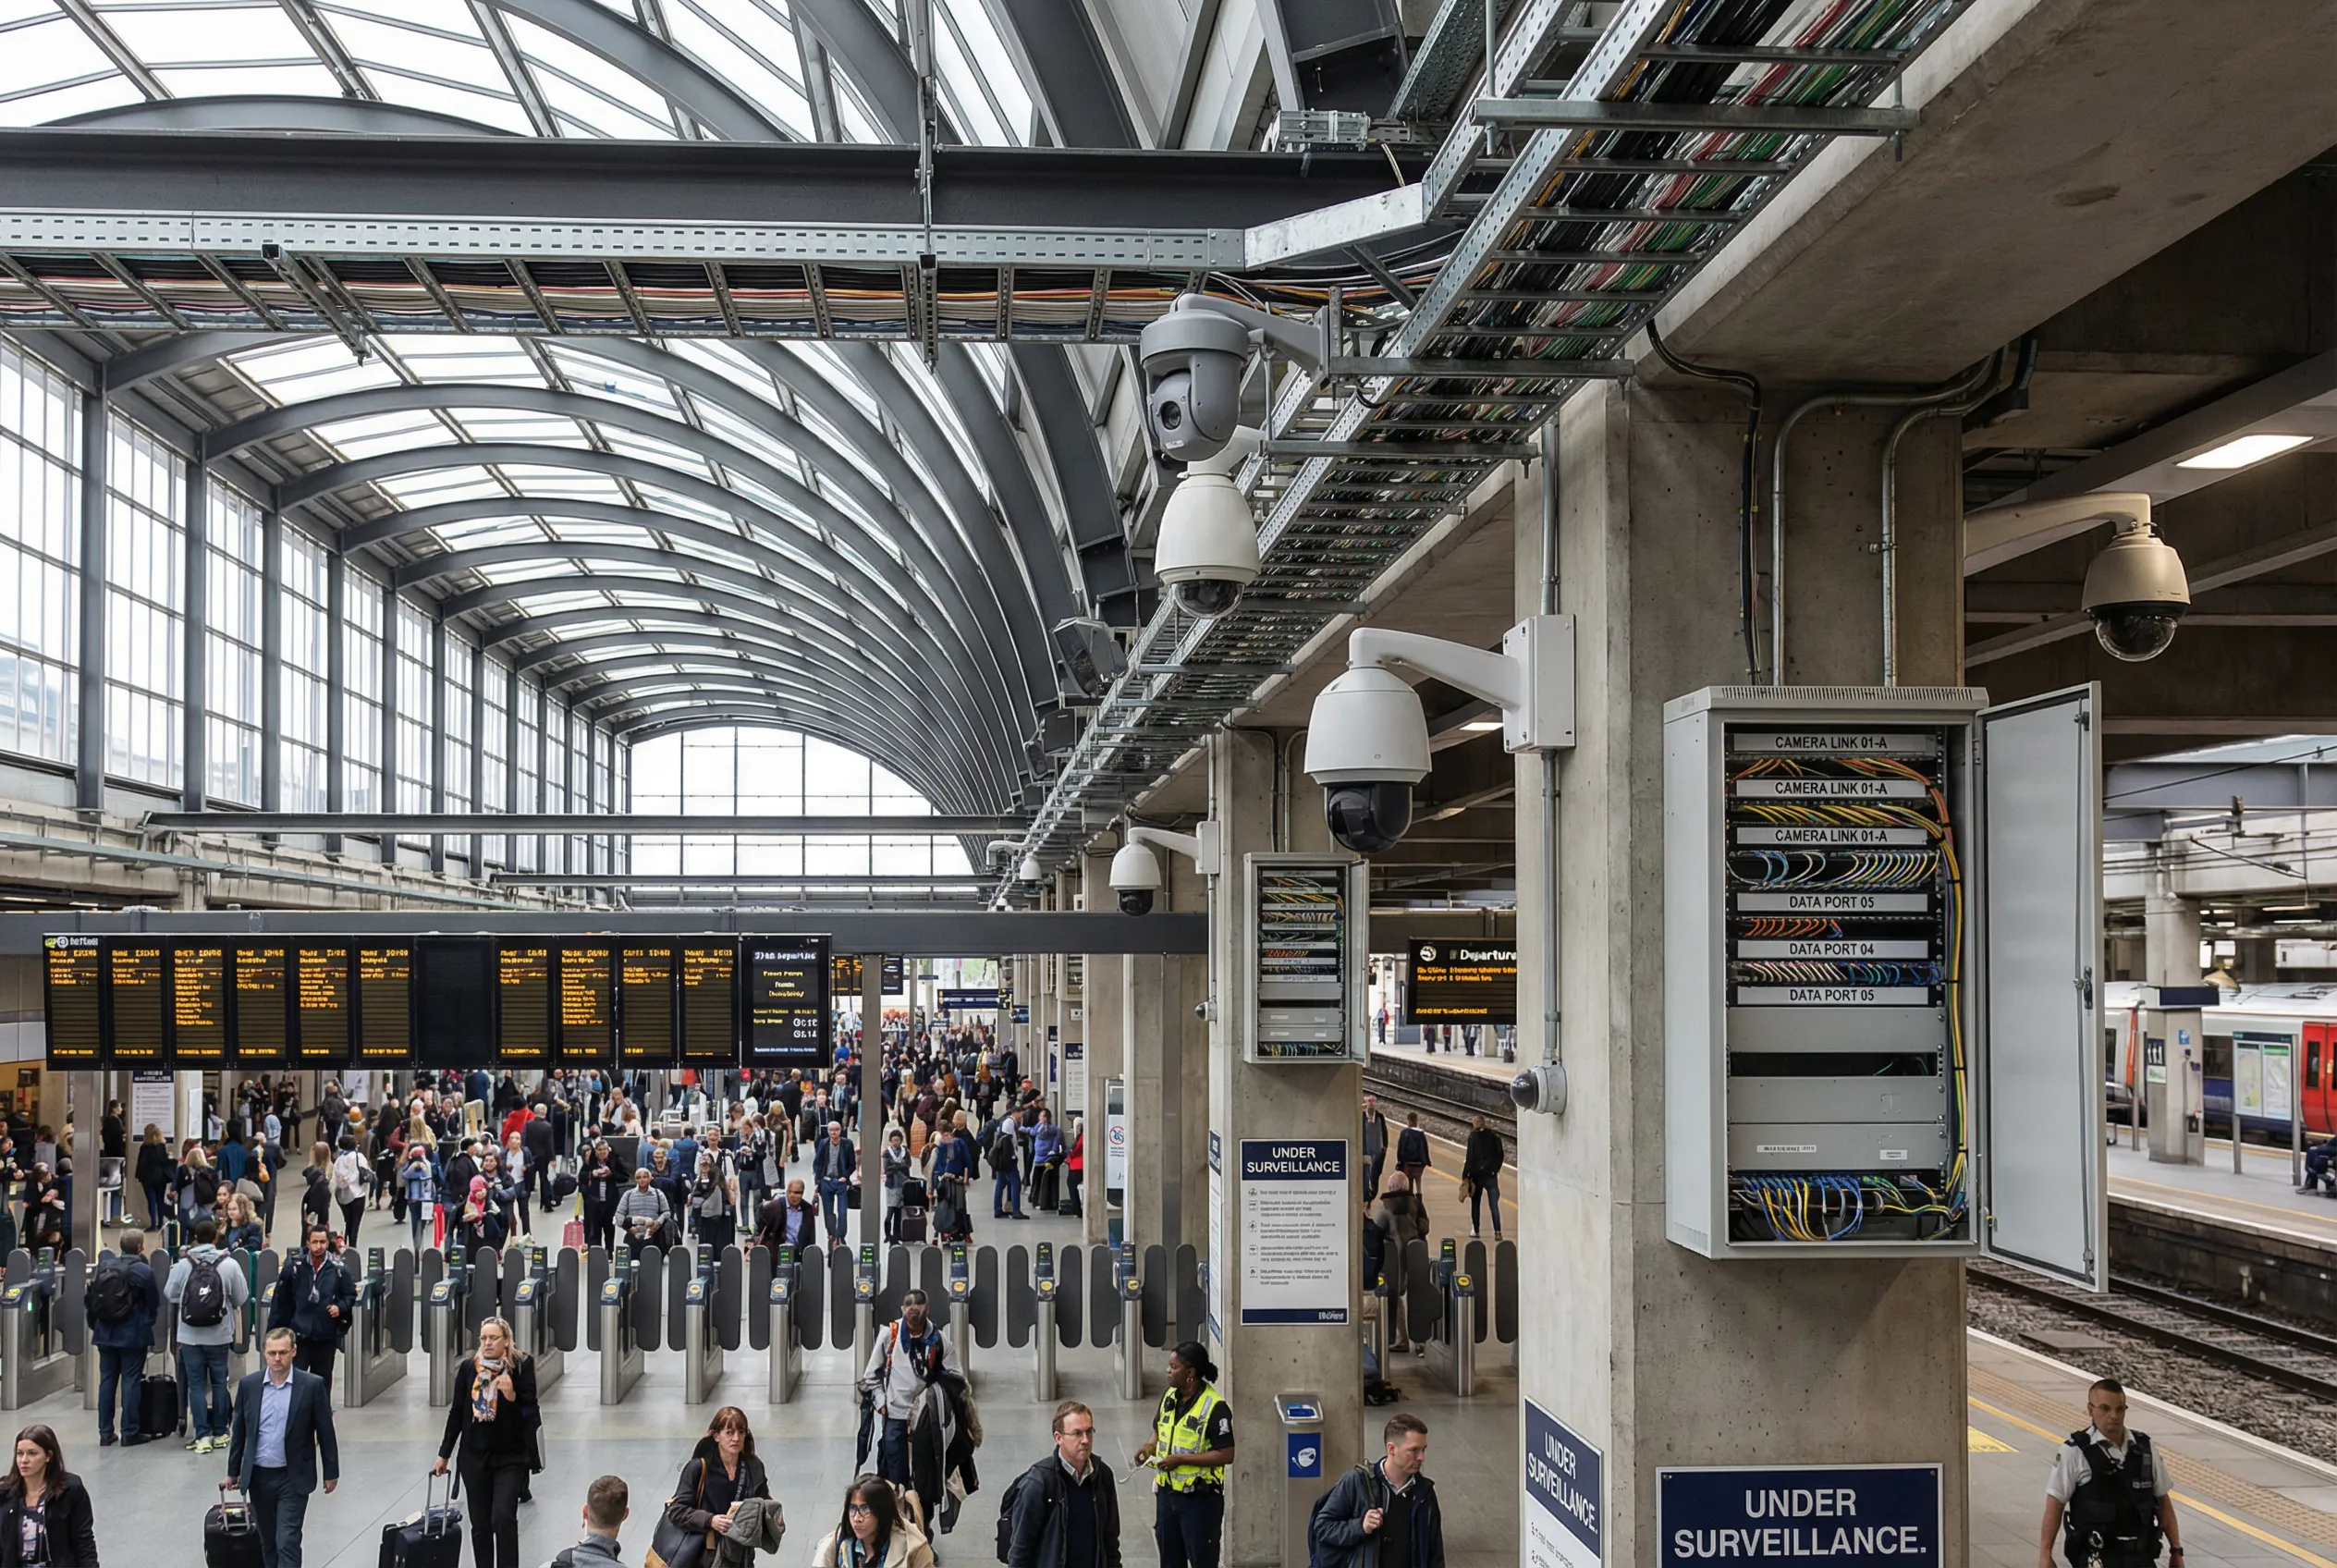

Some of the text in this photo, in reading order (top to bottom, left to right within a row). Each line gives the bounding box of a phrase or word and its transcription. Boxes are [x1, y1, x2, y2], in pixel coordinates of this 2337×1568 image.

[1775, 736, 1888, 749] CAMERA LINK 01-A
[1775, 782, 1888, 795] CAMERA LINK 01-A
[1775, 829, 1888, 842] CAMERA LINK 01-A
[1789, 896, 1875, 909] DATA PORT 05
[1789, 943, 1875, 956] DATA PORT 04
[1789, 988, 1875, 1001] DATA PORT 05
[1272, 1146, 1316, 1158] UNDER
[1246, 1160, 1340, 1173] SURVEILLANCE
[1545, 1431, 1576, 1480] UNDER
[1527, 1452, 1598, 1535] SURVEILLANCE.
[1745, 1488, 1857, 1519] UNDER
[1674, 1525, 1927, 1558] SURVEILLANCE.
